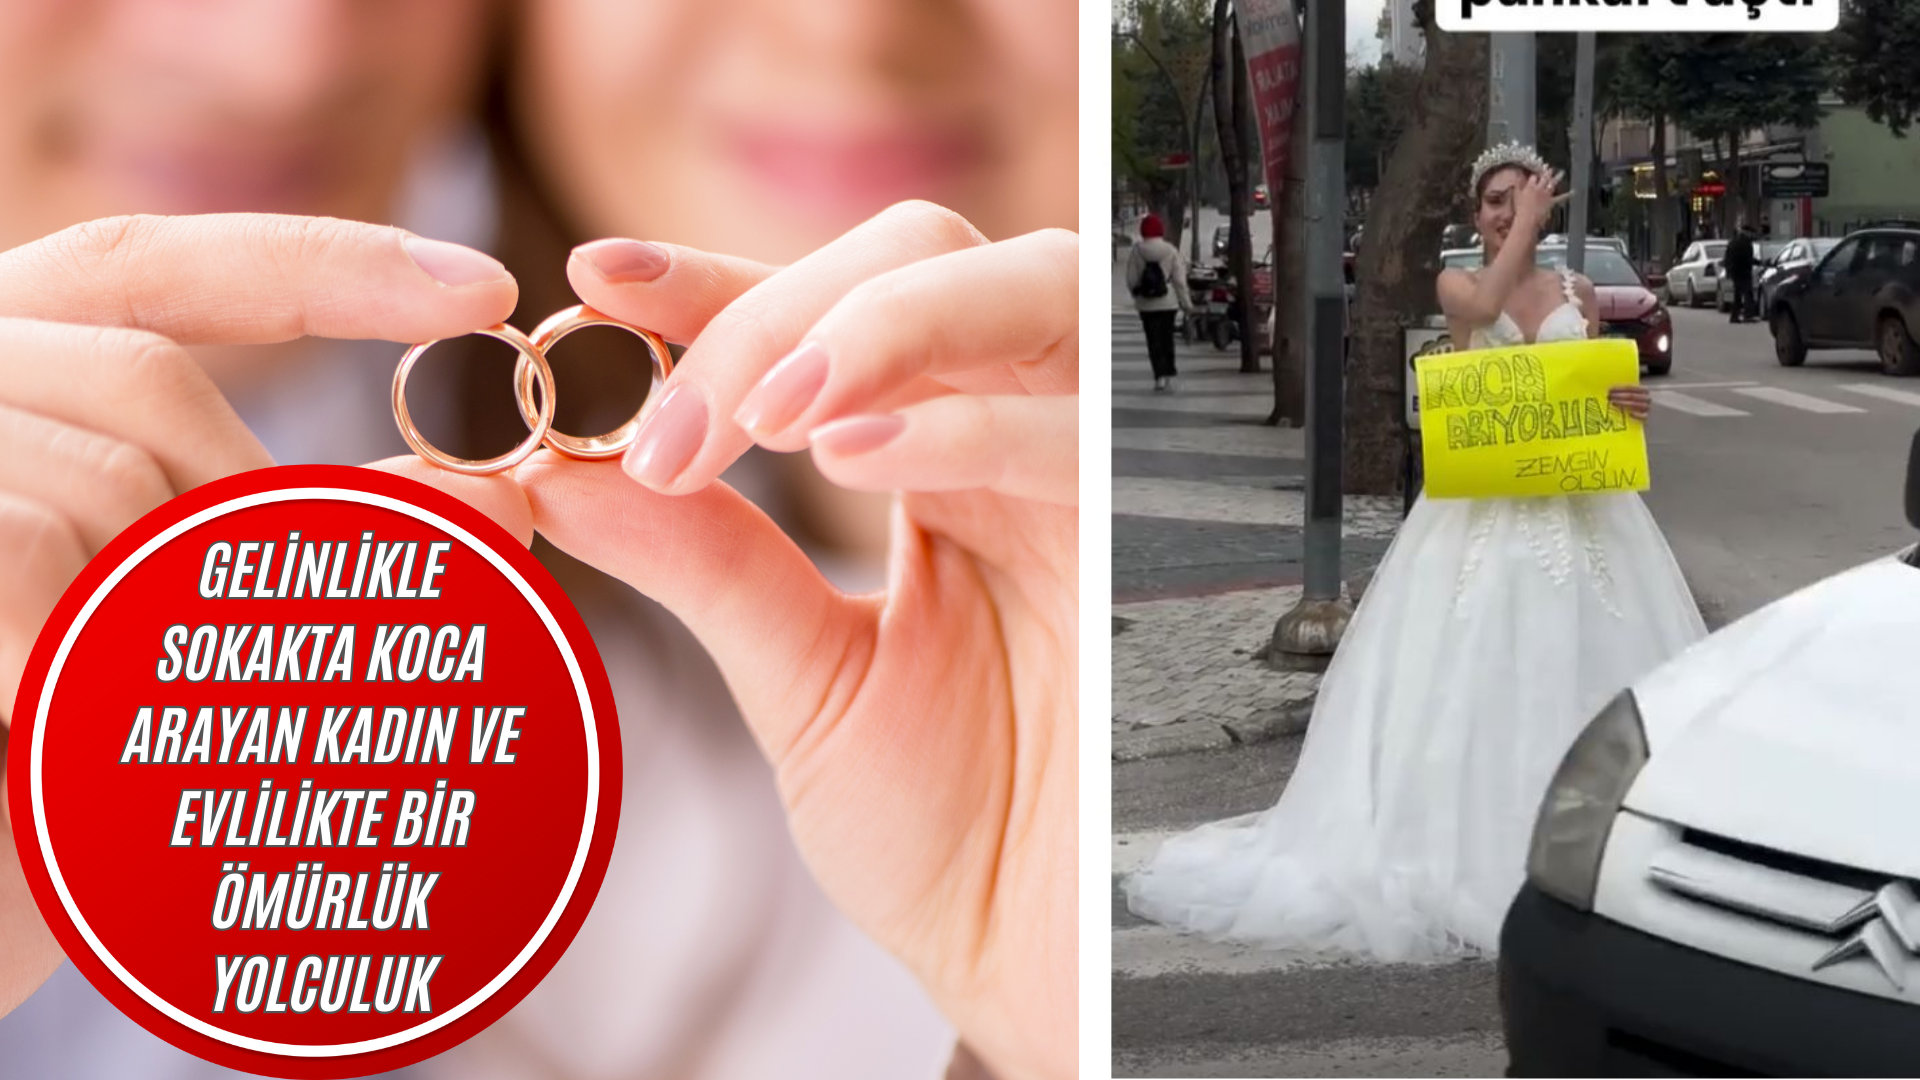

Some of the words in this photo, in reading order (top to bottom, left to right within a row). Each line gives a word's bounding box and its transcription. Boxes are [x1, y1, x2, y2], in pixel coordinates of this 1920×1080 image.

[1424, 353, 1547, 411] KOCA
[1447, 397, 1628, 451] ARIYORUM
[1514, 449, 1609, 478] ZENGIN
